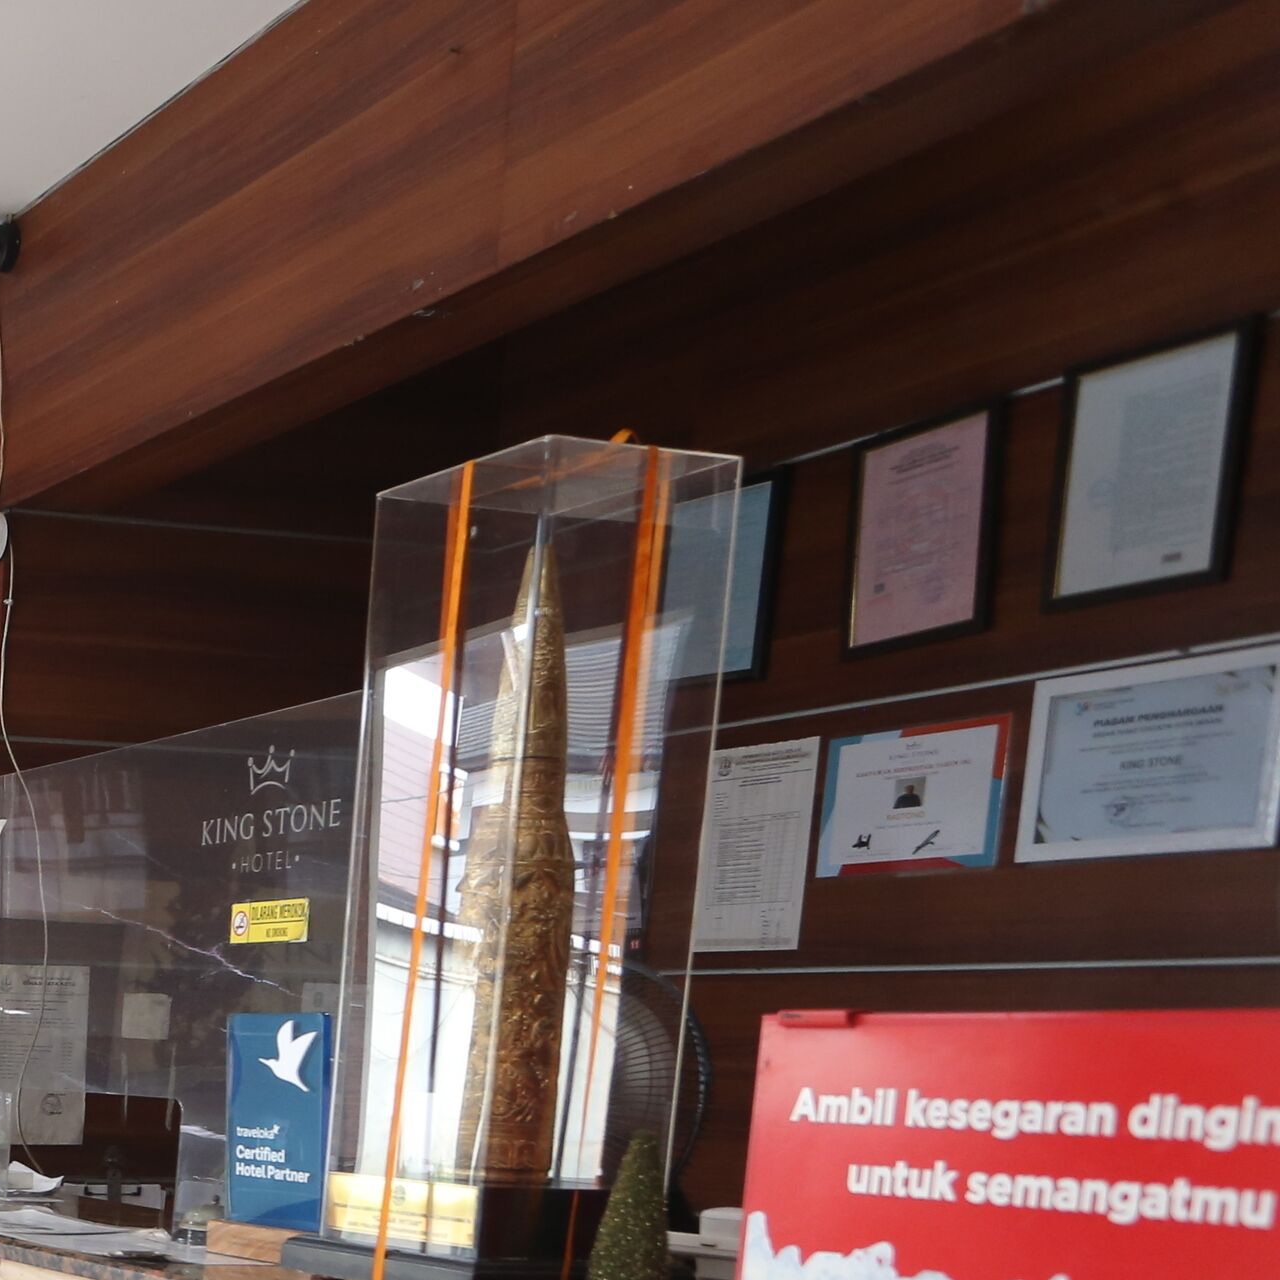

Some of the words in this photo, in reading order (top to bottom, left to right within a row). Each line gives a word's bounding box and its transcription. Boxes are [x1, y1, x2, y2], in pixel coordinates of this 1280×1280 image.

[201, 813, 255, 846] KING
[262, 799, 341, 837] STONE
[240, 851, 291, 873] HOTEL
[790, 1087, 894, 1127] Ambil
[903, 1088, 1116, 1140] kesegaran
[1127, 1093, 1280, 1152] dingin
[236, 1125, 275, 1139] traveloka
[236, 1144, 286, 1163] Certified
[235, 1161, 267, 1179] Hotel
[267, 1165, 311, 1183] Partner
[846, 1160, 959, 1202] untuk
[965, 1168, 1276, 1230] semangatmu
